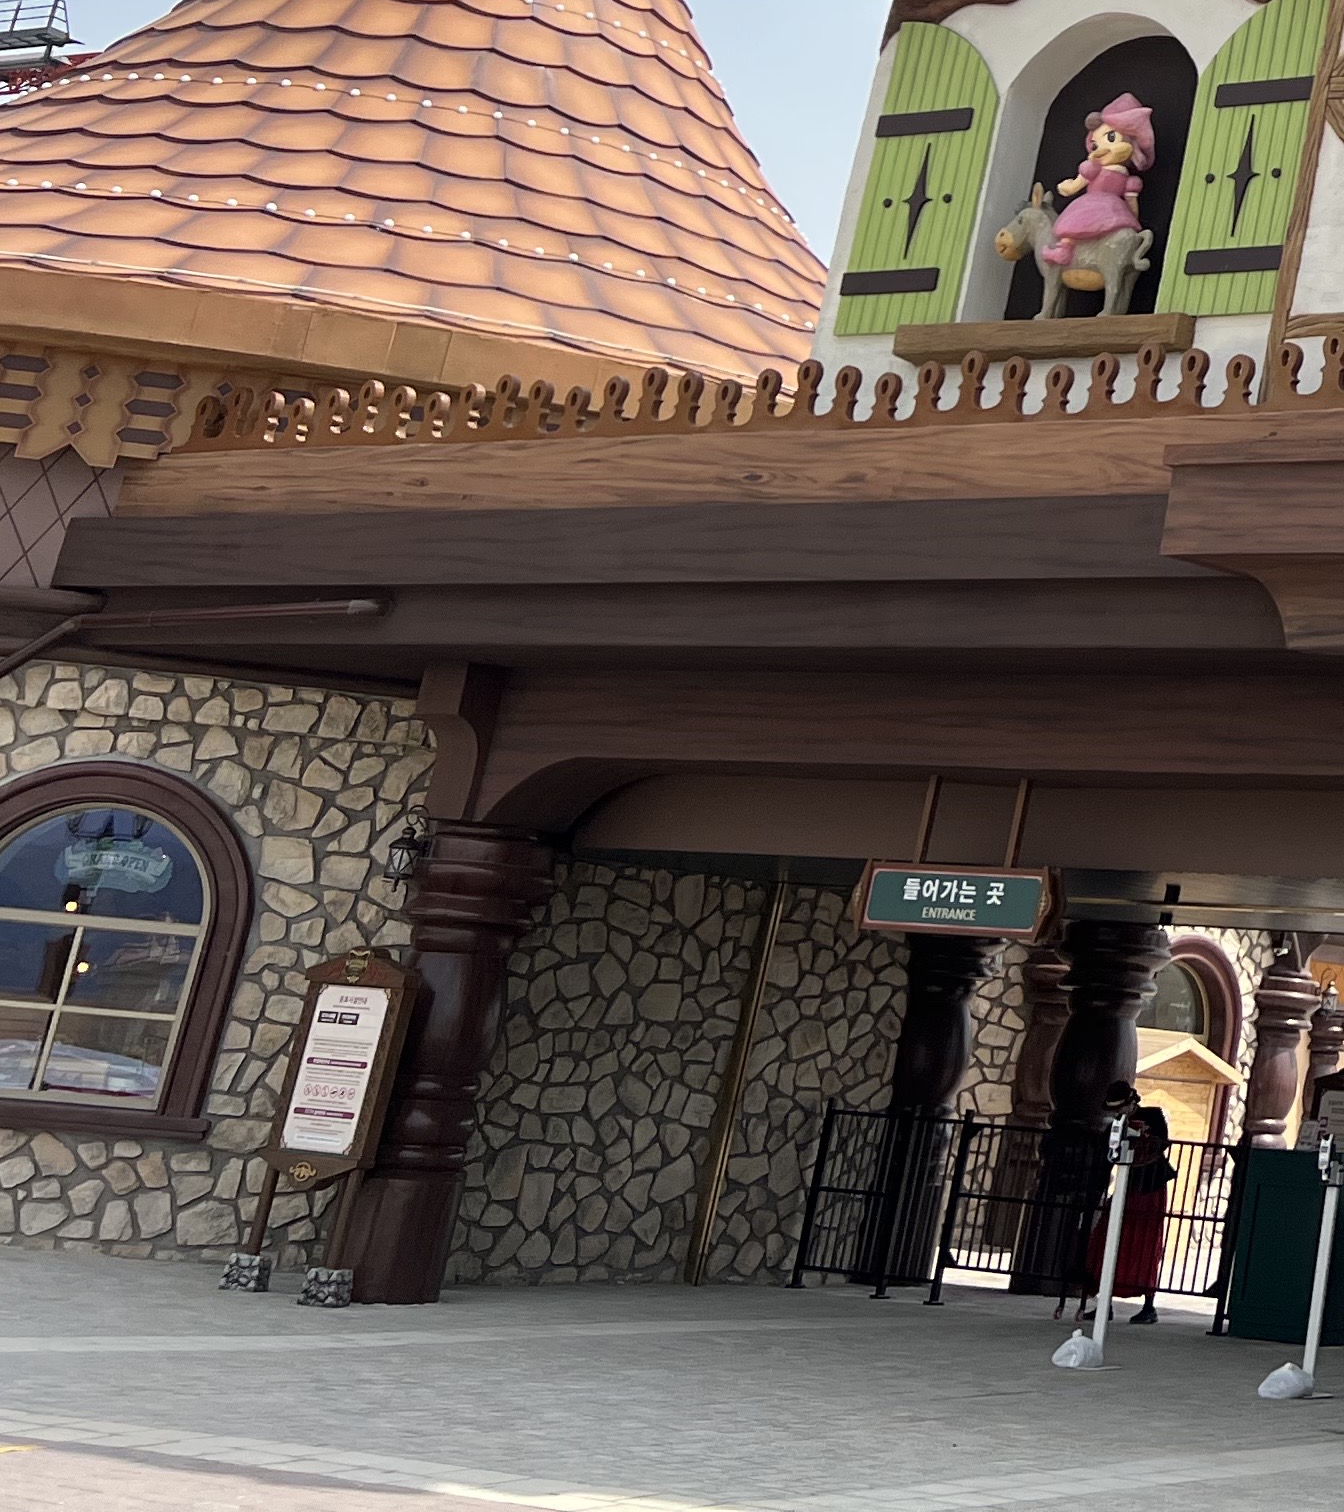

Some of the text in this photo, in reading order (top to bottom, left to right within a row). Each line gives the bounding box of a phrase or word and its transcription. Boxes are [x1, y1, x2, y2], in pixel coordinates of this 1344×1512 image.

[903, 877, 1005, 906] 들어가는 곳
[921, 906, 977, 921] ENTRANCE
